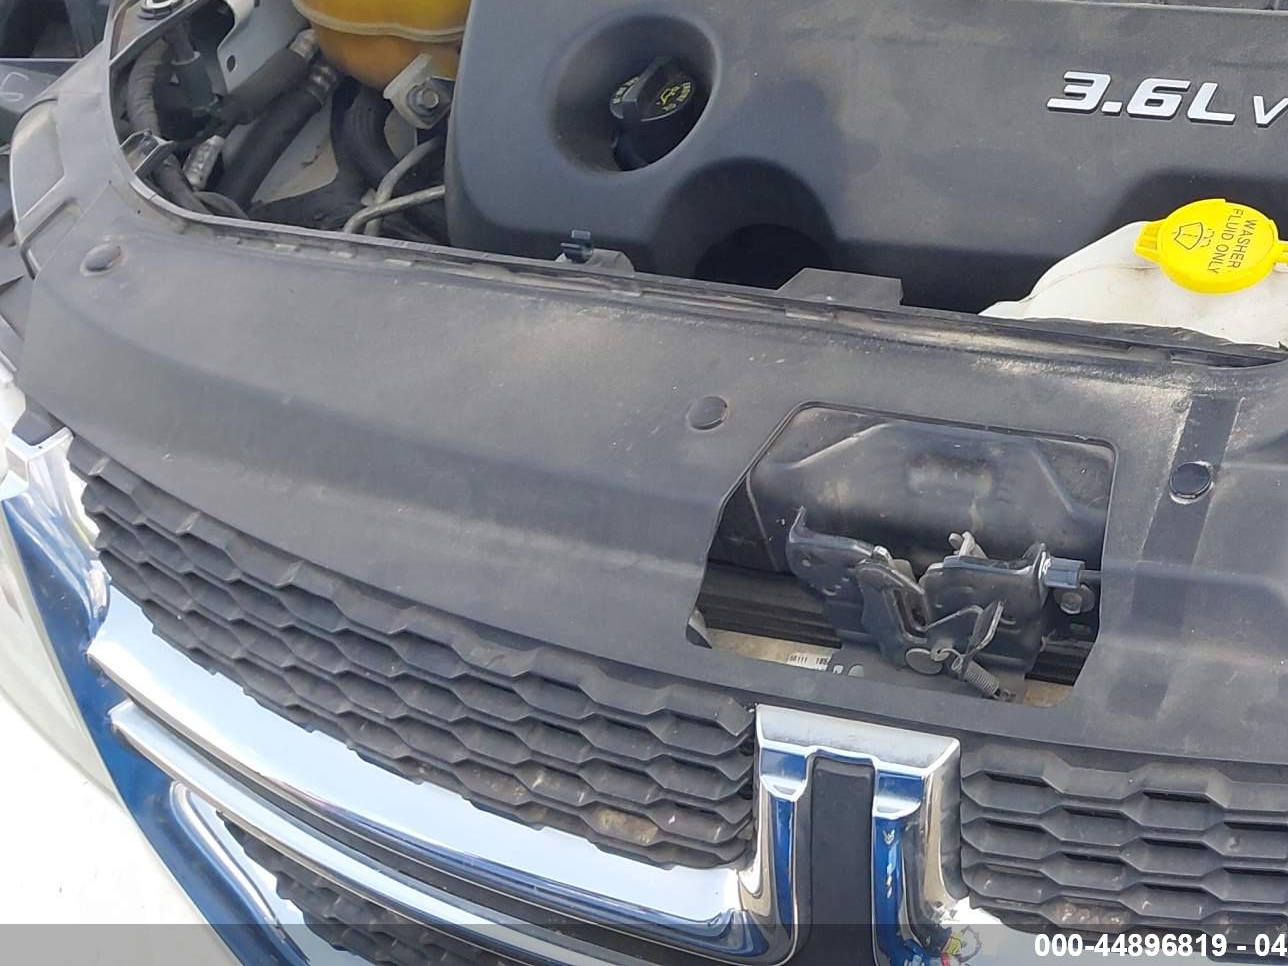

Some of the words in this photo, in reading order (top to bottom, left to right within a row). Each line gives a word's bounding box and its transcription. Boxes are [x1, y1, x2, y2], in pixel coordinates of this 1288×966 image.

[1047, 71, 1237, 125] 3.6L
[1220, 208, 1244, 241] FLUID
[1226, 219, 1258, 269] WASHER
[1207, 243, 1230, 274] ONLY
